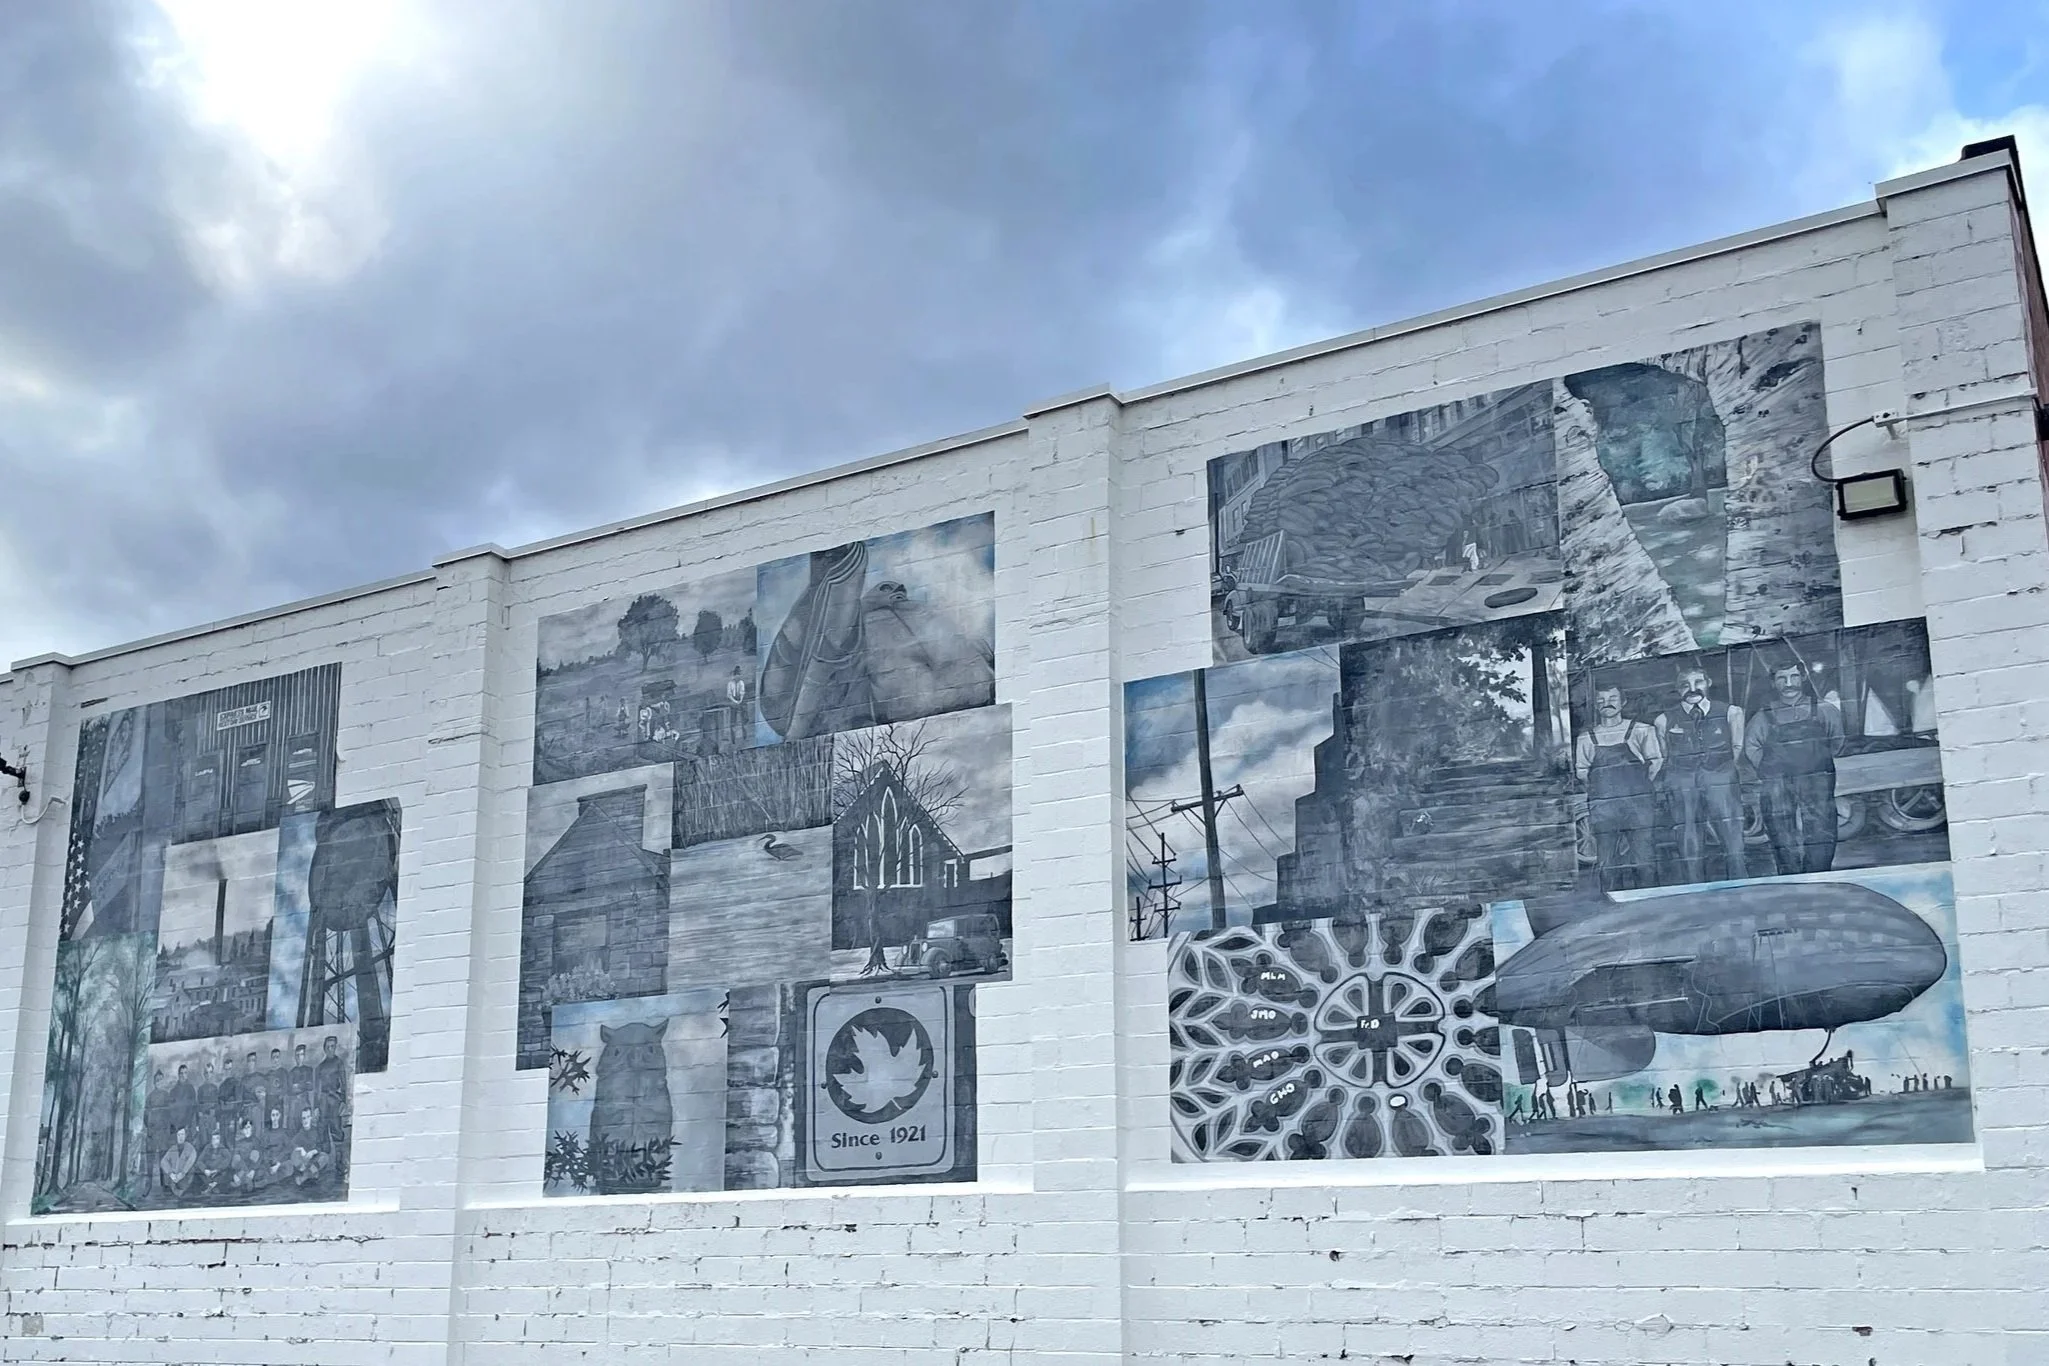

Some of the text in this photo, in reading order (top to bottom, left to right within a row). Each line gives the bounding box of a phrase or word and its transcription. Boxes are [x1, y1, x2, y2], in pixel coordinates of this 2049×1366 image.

[1261, 972, 1285, 980] MLM
[1251, 1010, 1276, 1019] JMO
[831, 1124, 926, 1148] Since 1921
